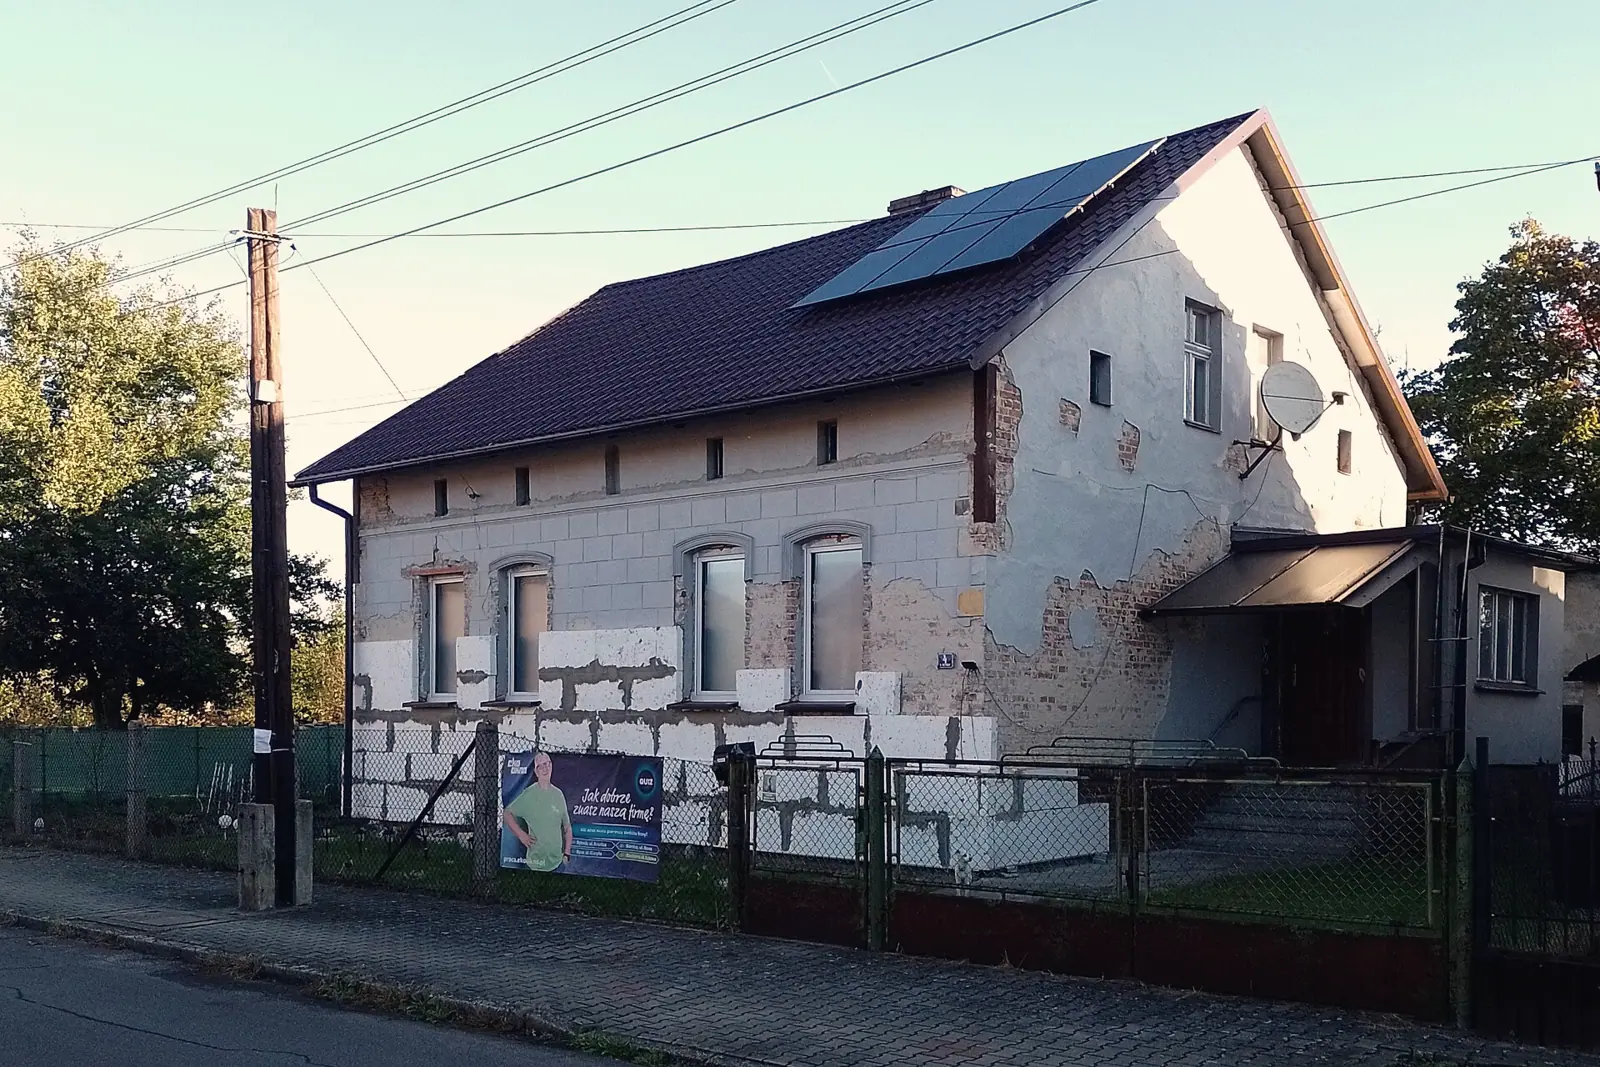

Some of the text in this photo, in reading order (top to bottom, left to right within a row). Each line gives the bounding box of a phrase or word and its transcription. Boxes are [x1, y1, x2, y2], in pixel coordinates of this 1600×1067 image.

[639, 778, 654, 786] QUIZ
[581, 788, 632, 804] Jak dobrze
[572, 804, 655, 823] znasz naszą firmę?
